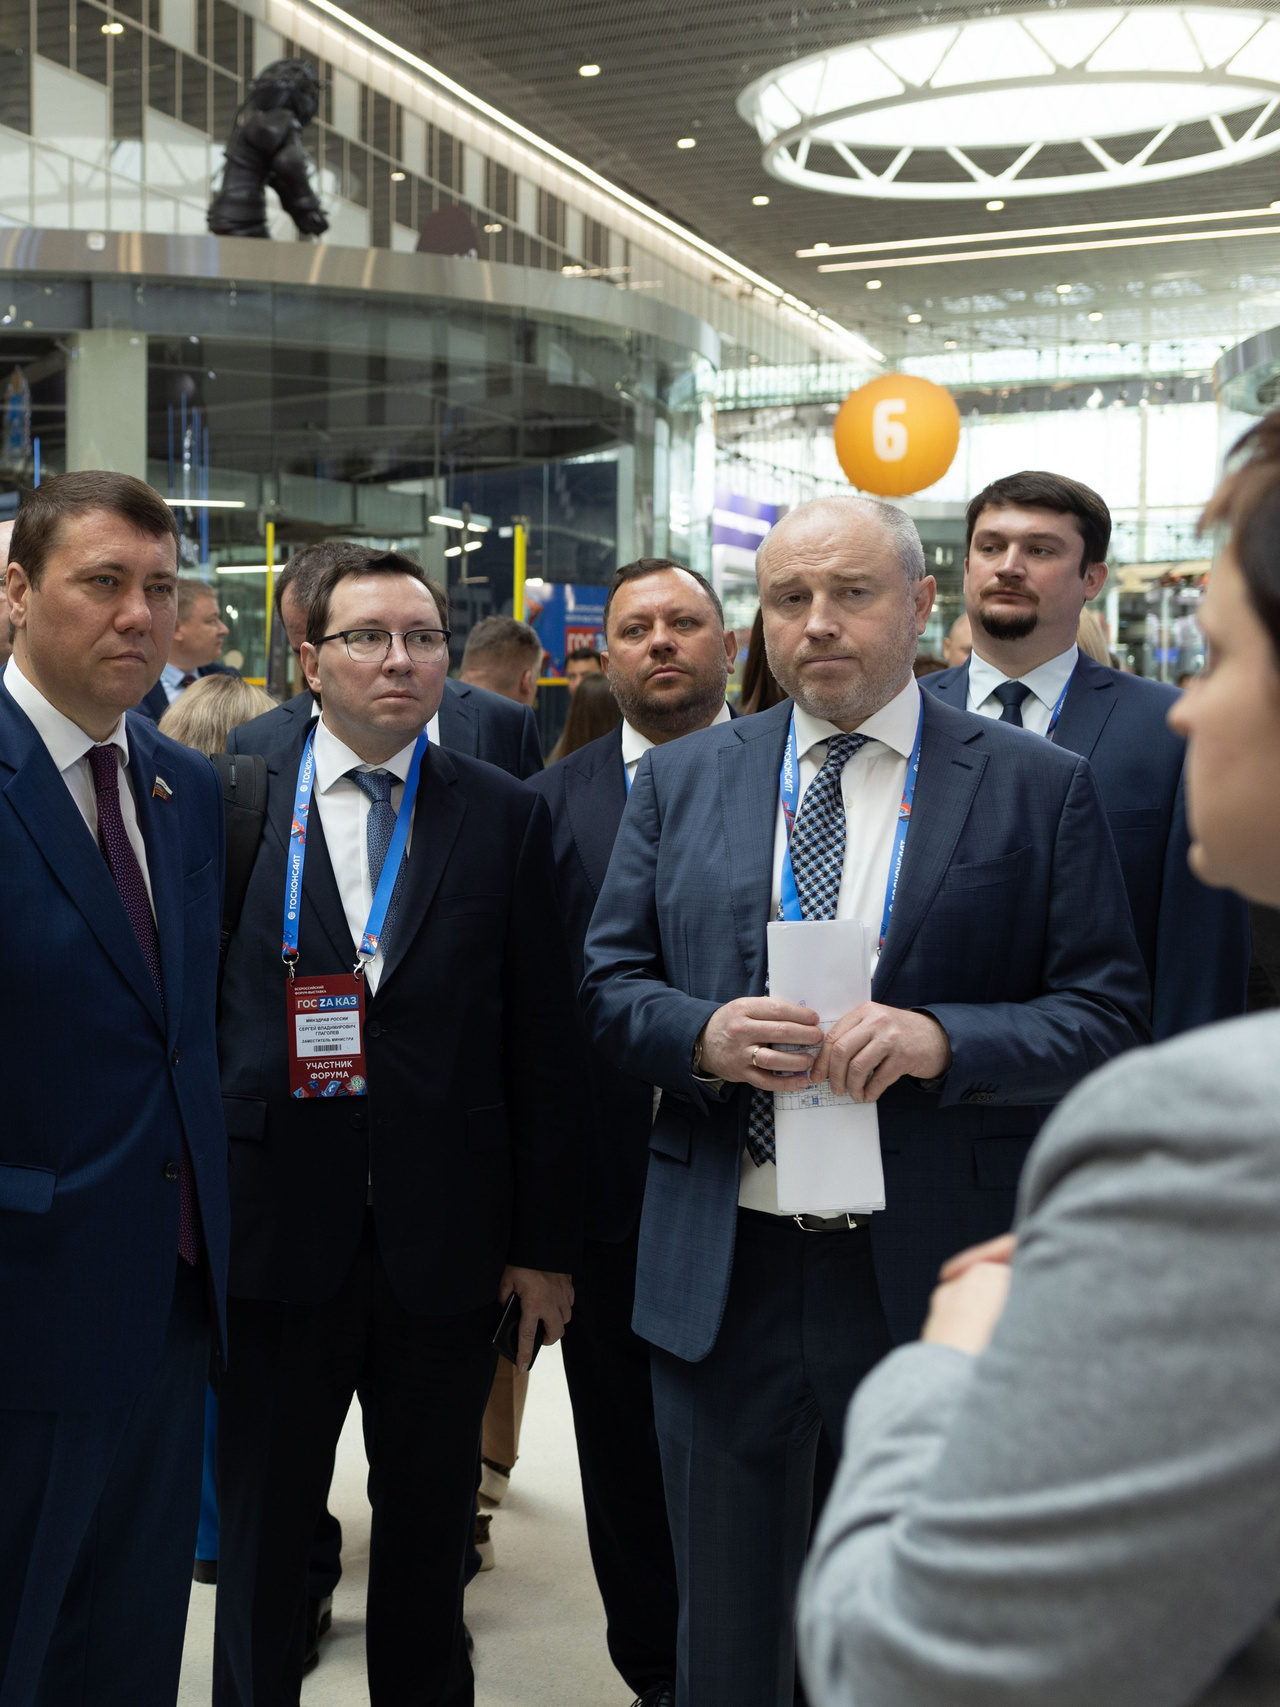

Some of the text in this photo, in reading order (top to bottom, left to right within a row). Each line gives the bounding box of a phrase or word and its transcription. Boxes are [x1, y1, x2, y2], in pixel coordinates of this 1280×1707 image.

[873, 398, 908, 462] 6
[290, 854, 302, 909] ГОСКОНСАЛТ
[306, 1061, 353, 1070] УЧАСТНИК
[310, 1071, 349, 1079] ФОРУМА
